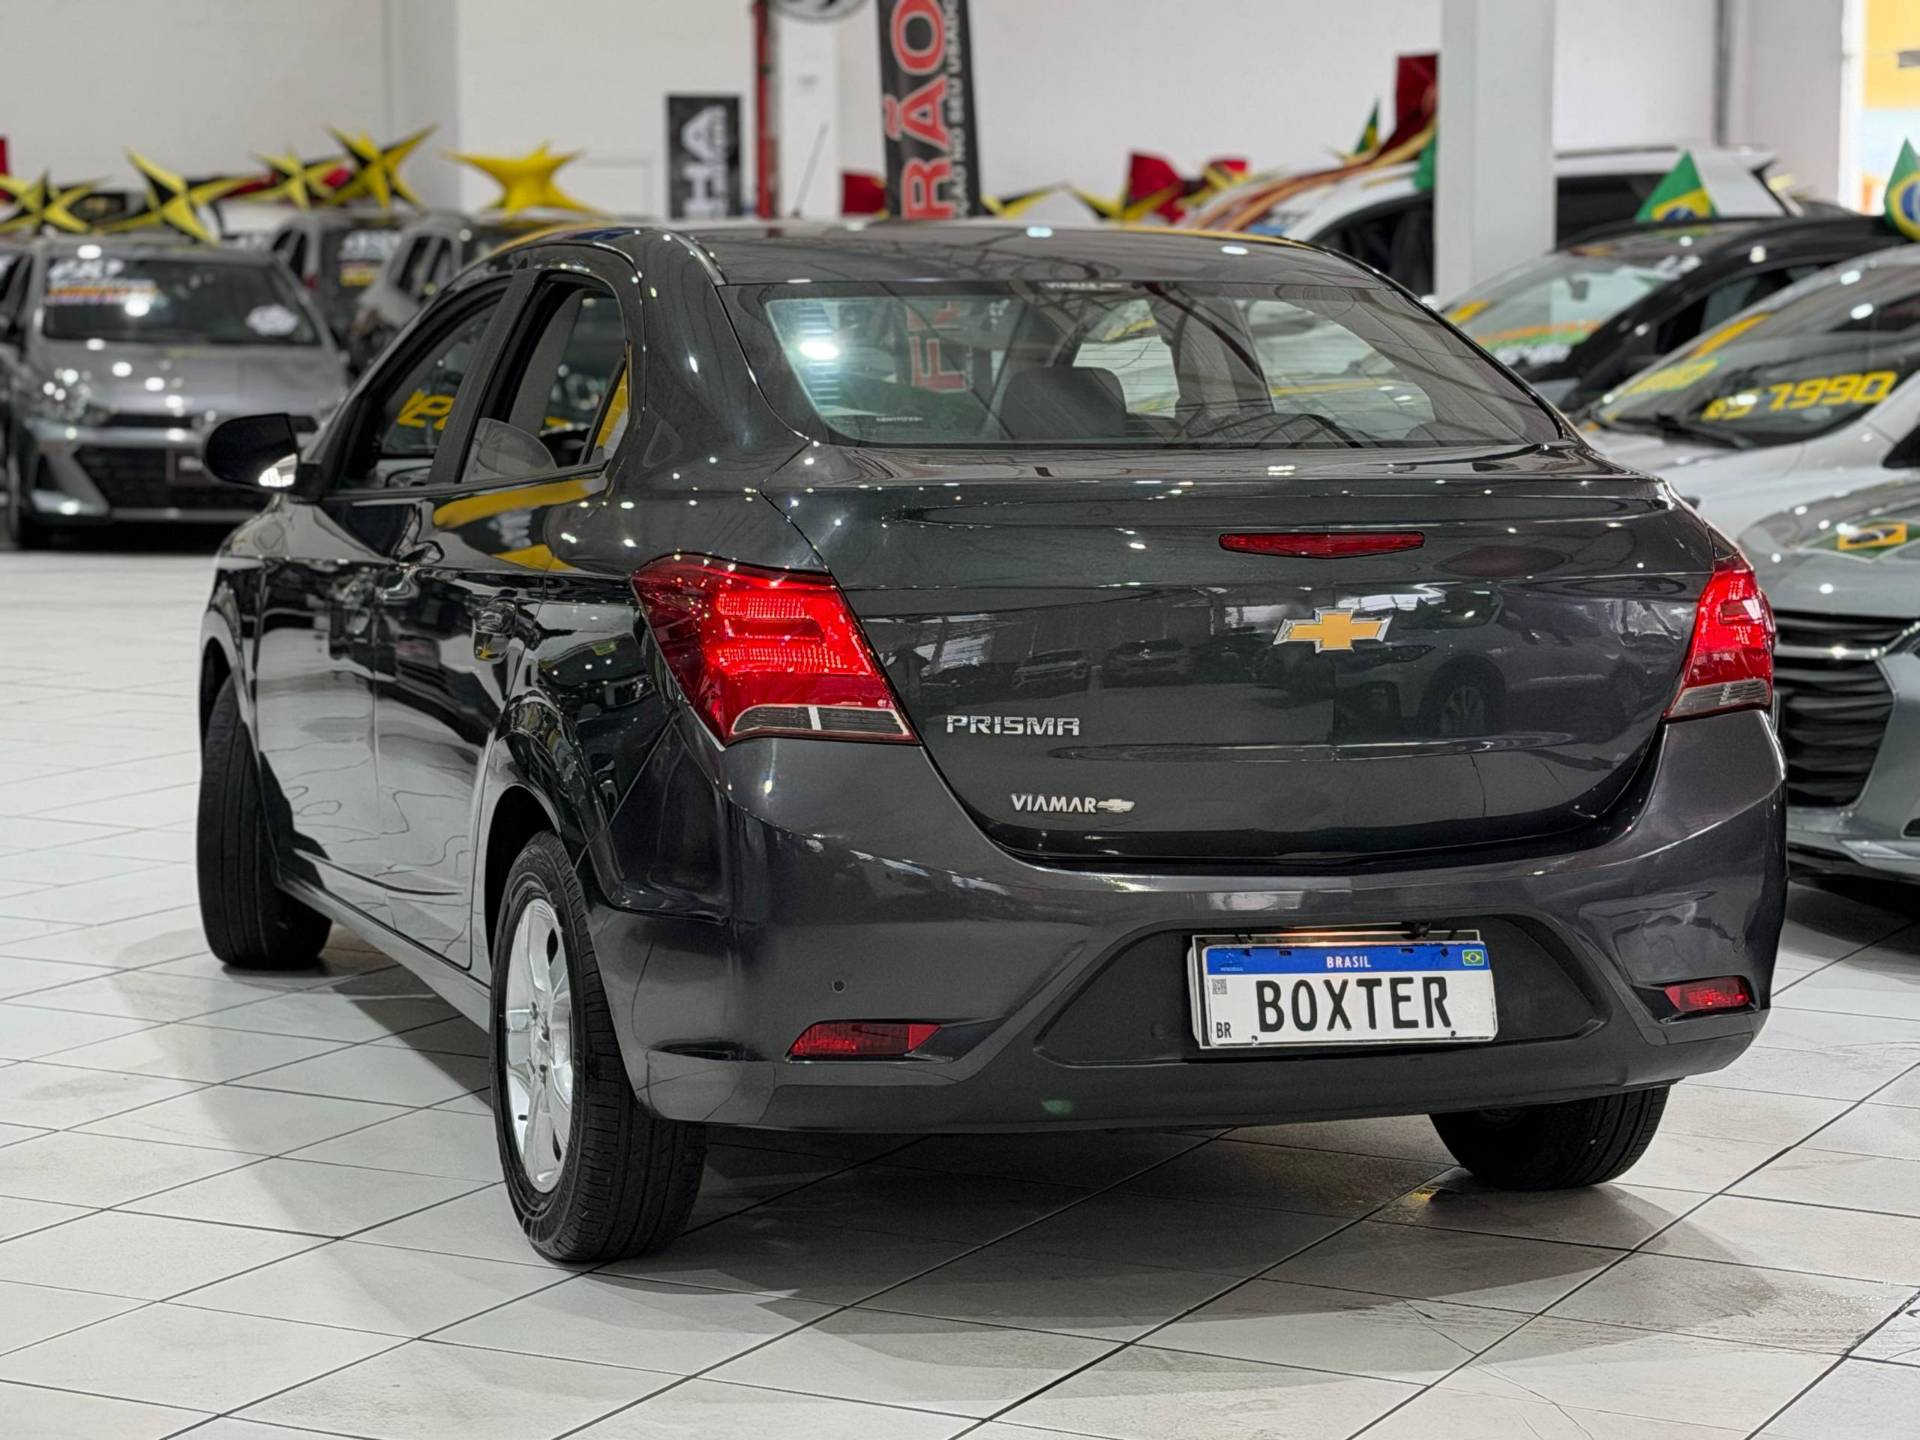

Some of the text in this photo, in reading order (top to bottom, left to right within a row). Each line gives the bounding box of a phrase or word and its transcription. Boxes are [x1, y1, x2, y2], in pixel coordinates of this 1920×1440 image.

[947, 715, 1080, 735] PRISMA
[1011, 794, 1096, 813] VIAMAR
[1326, 955, 1371, 968] BRASIL
[1256, 976, 1451, 1032] BOXTER
[1215, 1022, 1232, 1039] BR
